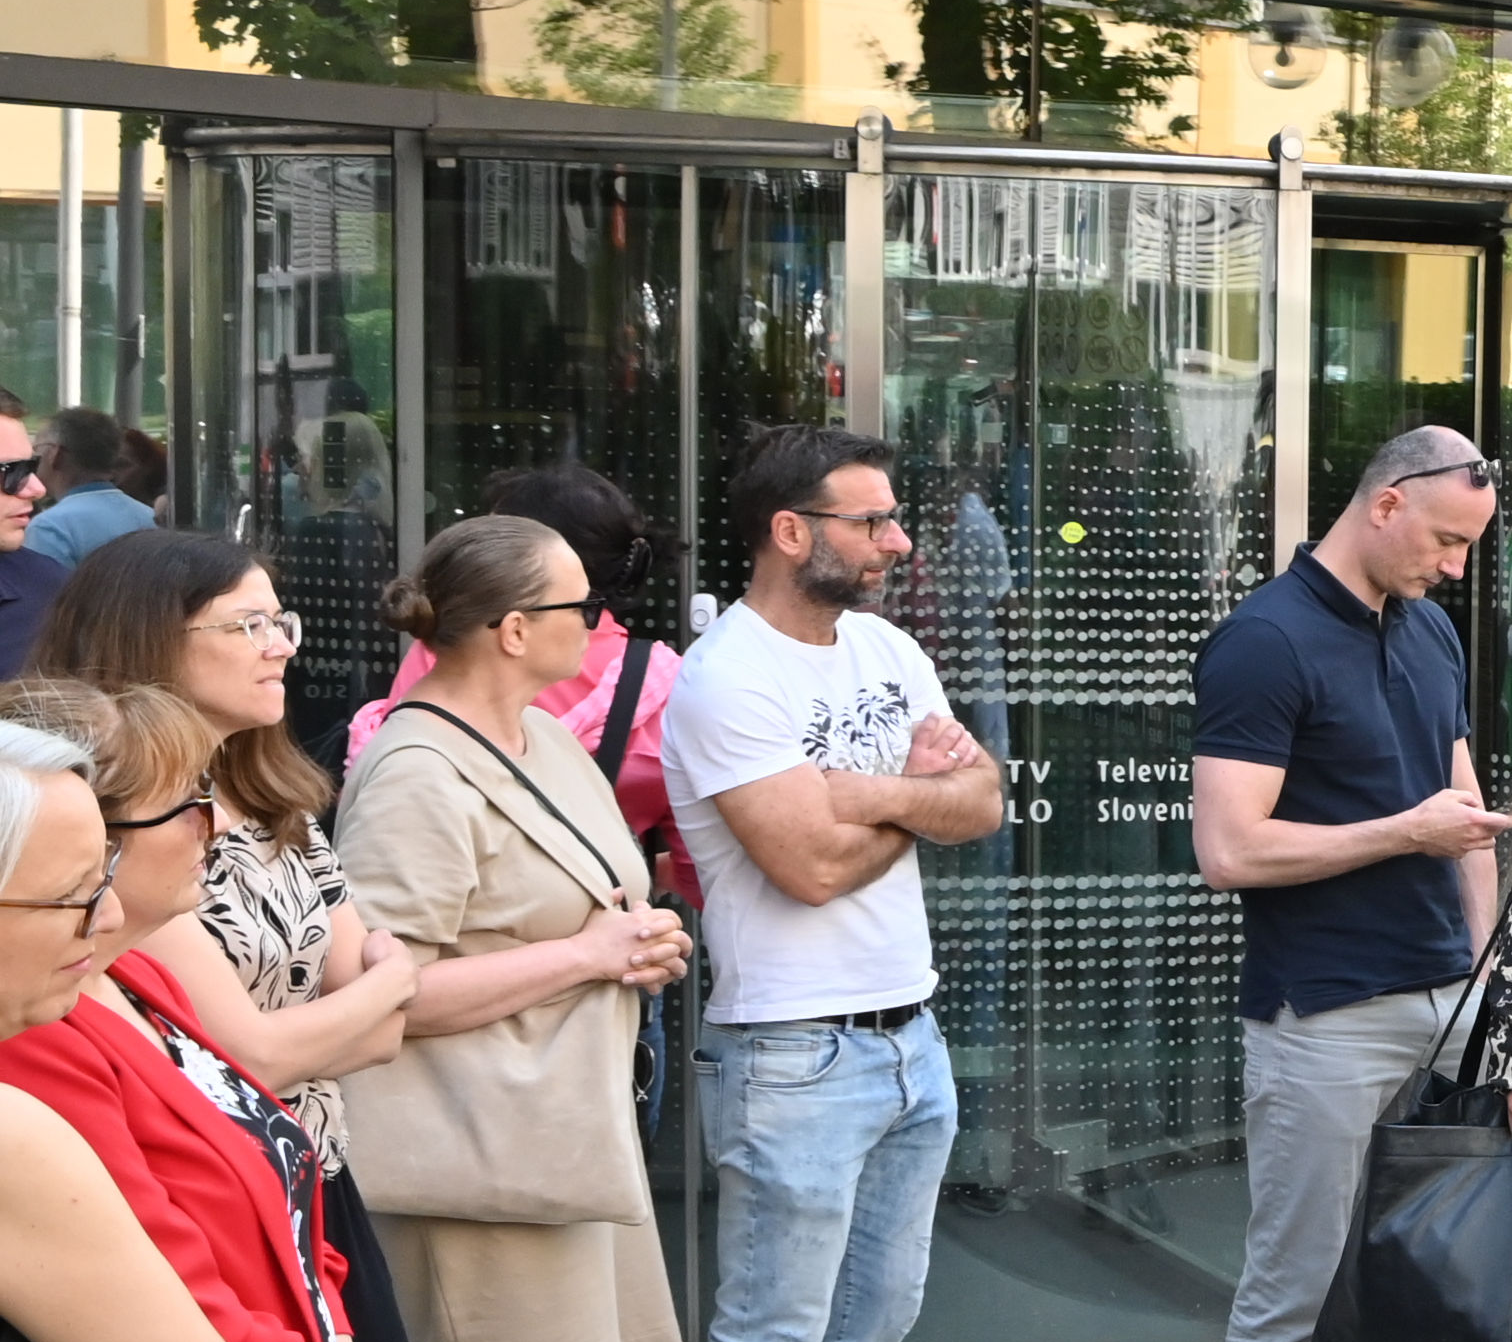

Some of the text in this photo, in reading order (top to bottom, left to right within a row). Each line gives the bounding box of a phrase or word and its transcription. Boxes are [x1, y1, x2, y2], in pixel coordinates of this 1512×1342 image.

[1005, 757, 1190, 784] TV Televiz
[1007, 795, 1194, 824] LO Sloveni
